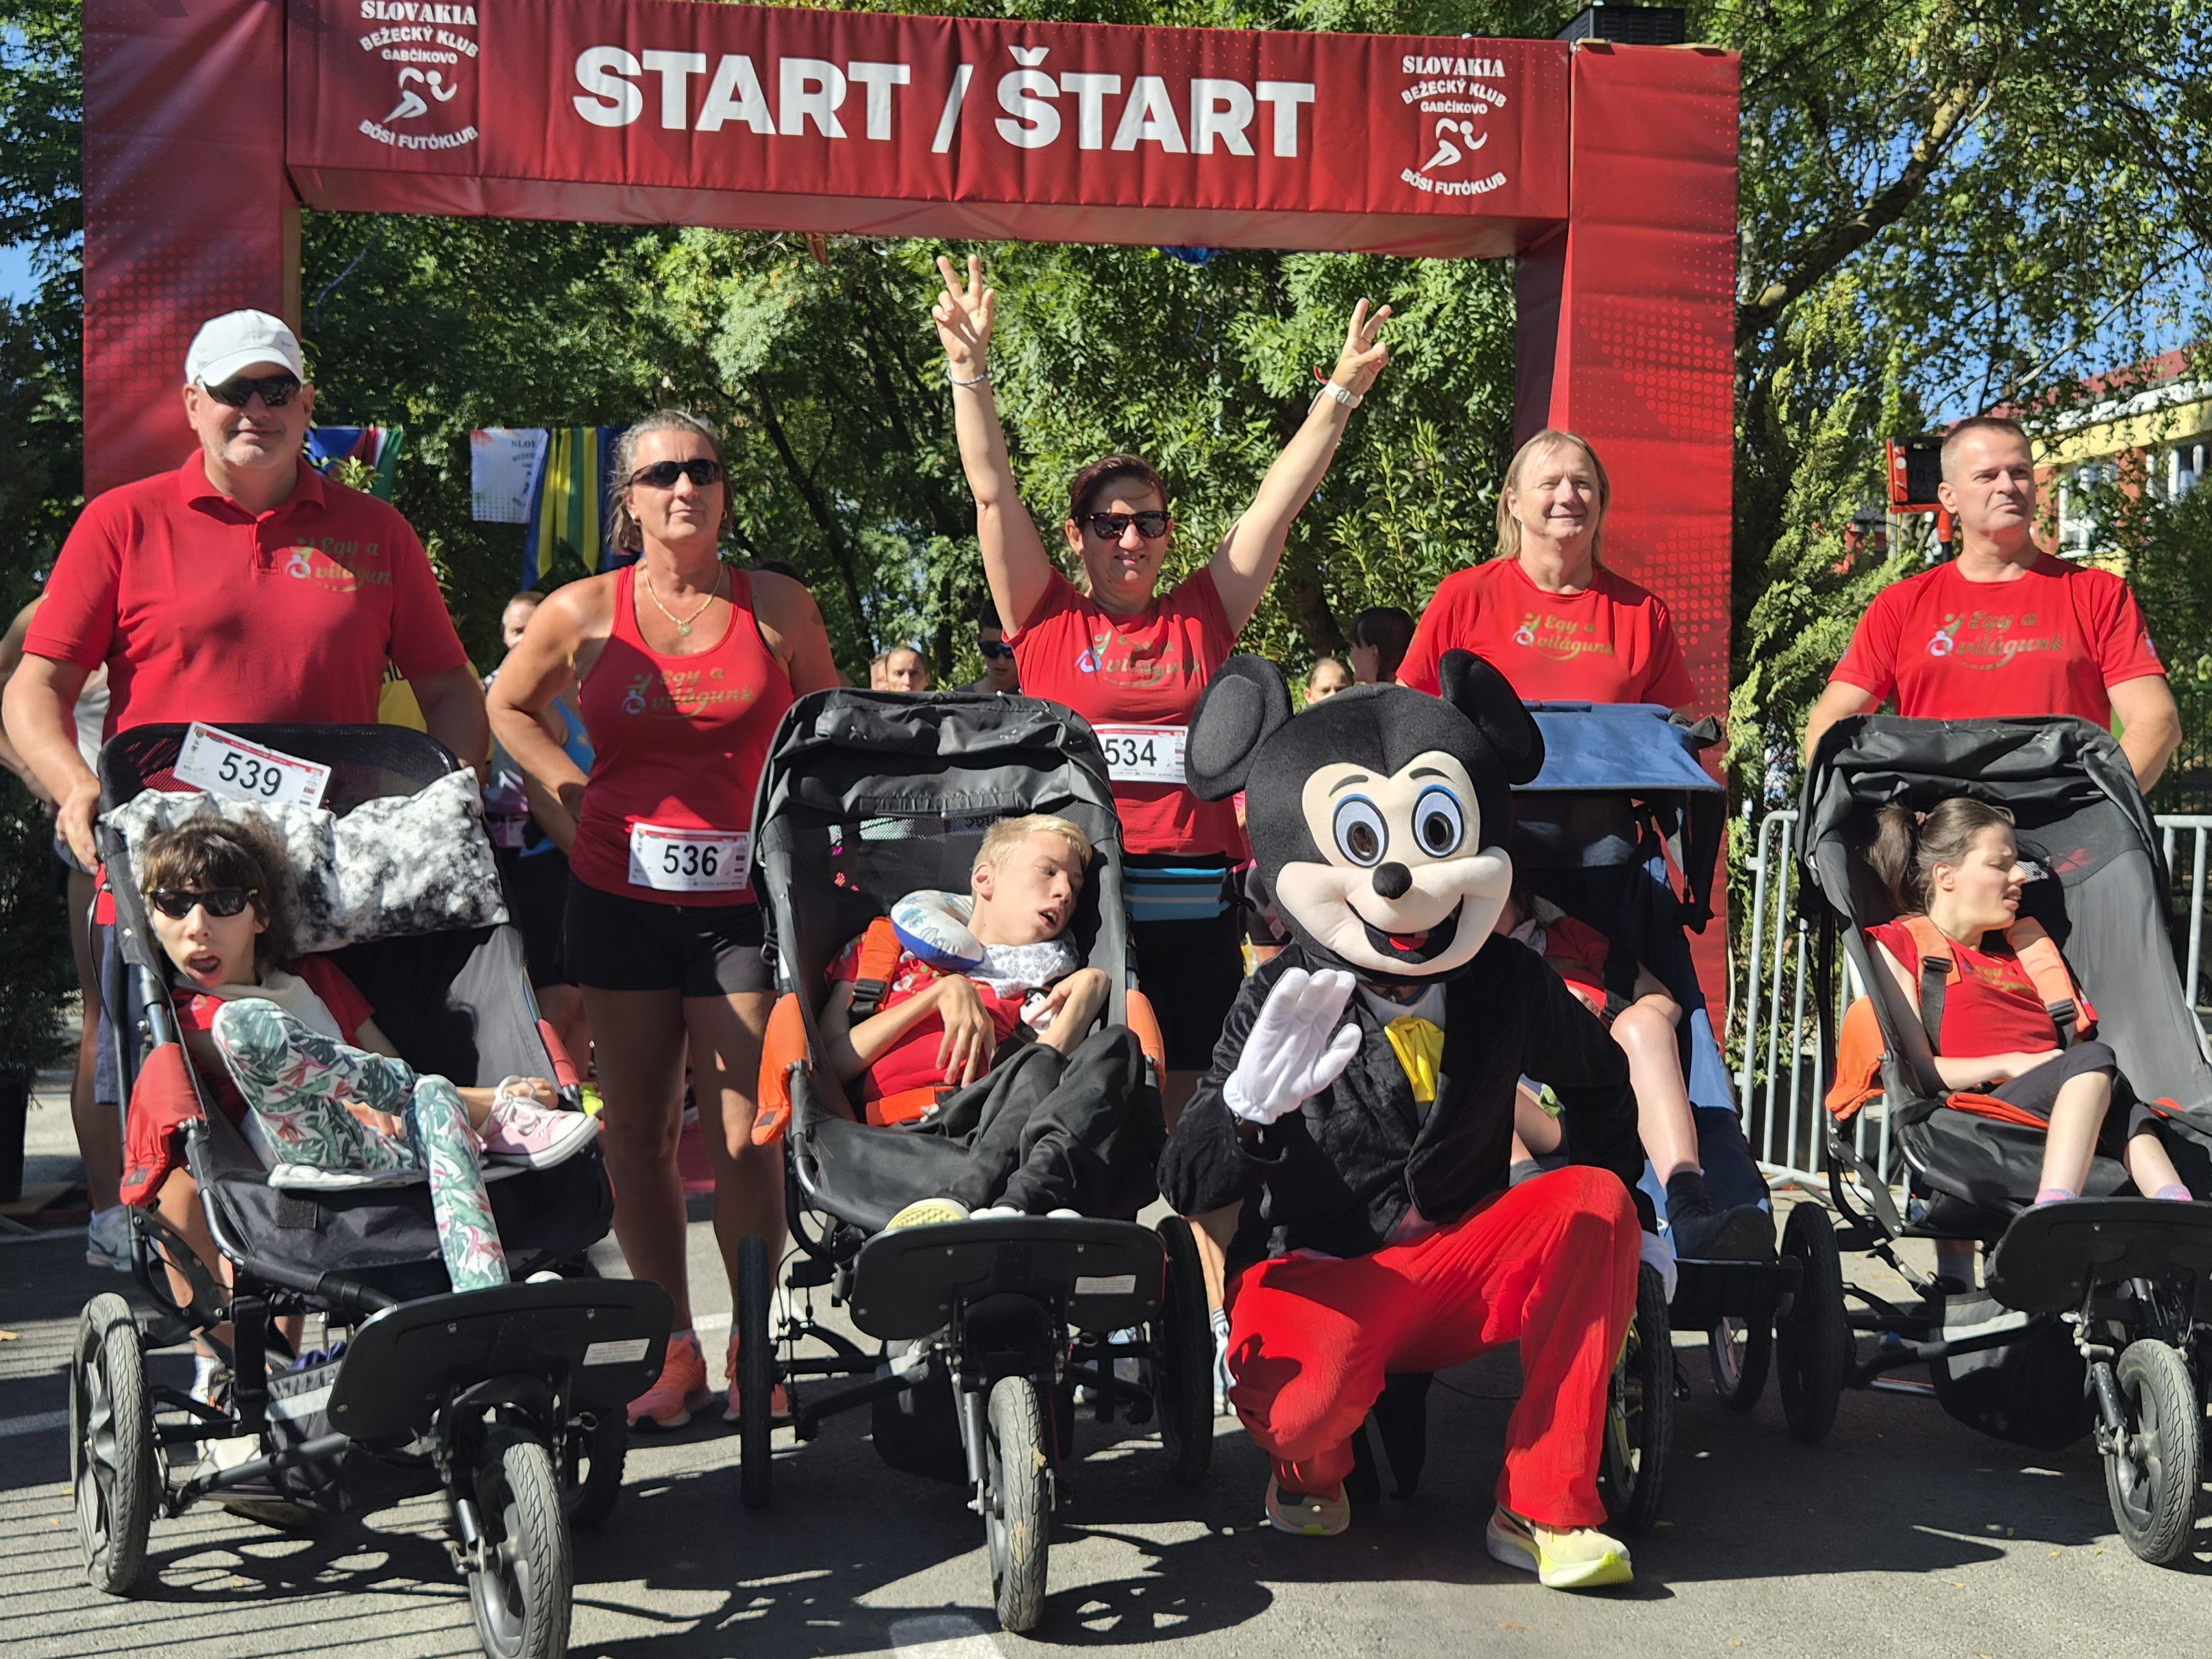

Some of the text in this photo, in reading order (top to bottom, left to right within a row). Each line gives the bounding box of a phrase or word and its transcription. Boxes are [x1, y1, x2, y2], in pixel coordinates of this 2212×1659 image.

[361, 0, 478, 25] SLOVAKIA
[359, 25, 479, 58] BEŽECKÝ KLUB
[381, 48, 458, 65] GABČÍKOVO
[1402, 54, 1506, 78] SLOVAKIA
[572, 44, 1316, 158] START / ŠTART
[1401, 77, 1507, 108] BEŽECKÝ KLUB
[1420, 100, 1489, 114] GABČÍKOVO
[397, 126, 479, 150] FUTÓKLUB
[1434, 171, 1507, 196] FUTÓKLUB
[366, 542, 379, 556] a
[1545, 614, 1596, 635] Egy a
[1968, 610, 2037, 634] Egy a
[1957, 633, 2064, 665] világunk
[709, 666, 724, 680] a
[1104, 738, 1157, 768] 534
[218, 750, 283, 797] 539
[662, 843, 719, 877] 536
